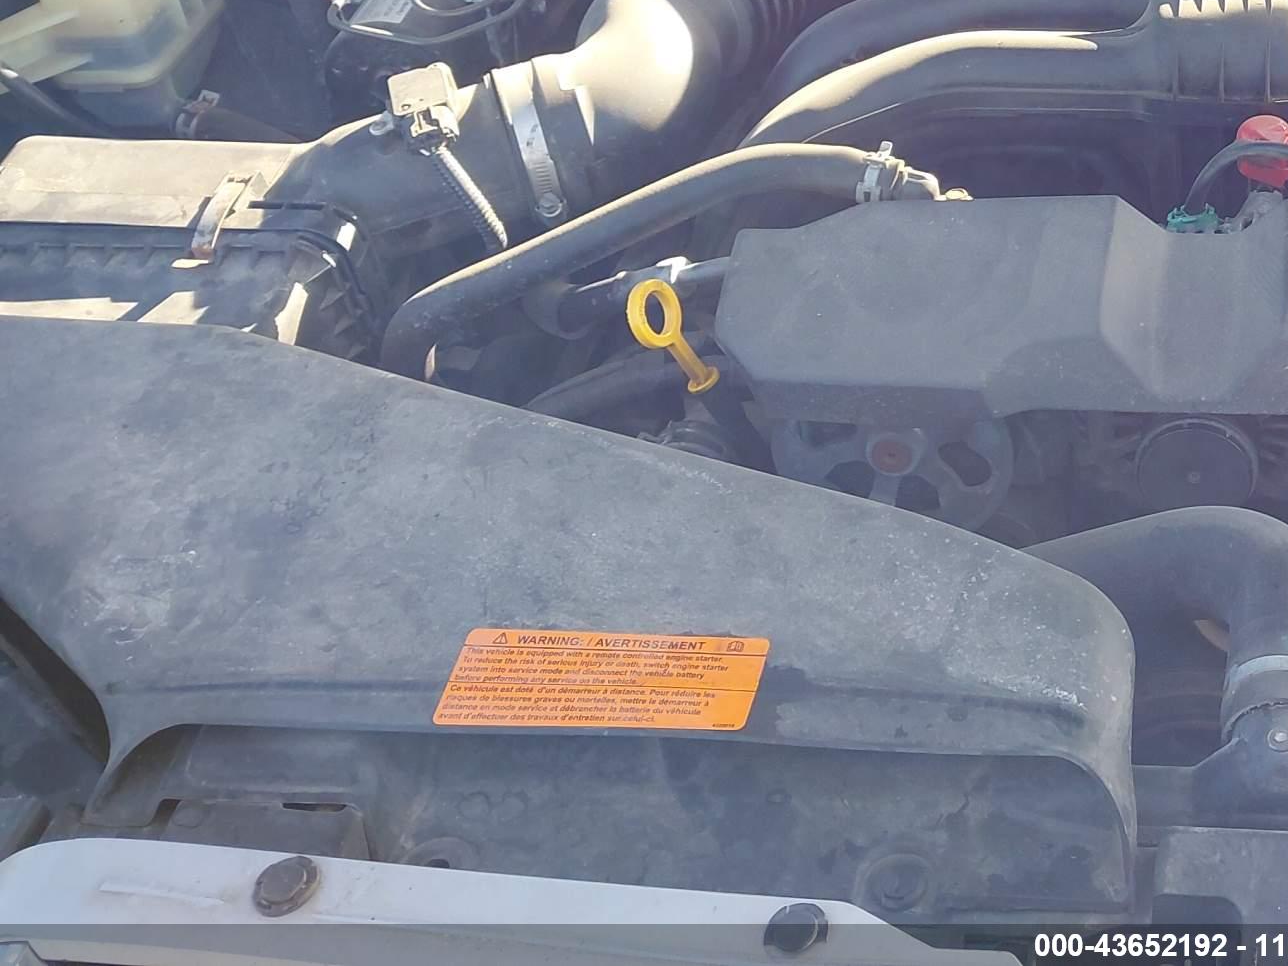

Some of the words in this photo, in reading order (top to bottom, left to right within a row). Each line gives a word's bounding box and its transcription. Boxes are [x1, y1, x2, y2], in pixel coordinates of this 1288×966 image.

[517, 634, 583, 646] WARNING:
[594, 638, 705, 650] AVERTISSEMENT
[526, 649, 563, 658] equipped
[622, 652, 664, 660] controlled
[665, 654, 693, 662] engine
[580, 660, 602, 668] injury
[643, 661, 669, 669] switch
[671, 663, 700, 671] engine
[458, 665, 487, 673] system
[582, 668, 627, 676] disconnect
[676, 671, 704, 679] battery
[483, 674, 528, 683] performing
[530, 676, 545, 684] any
[463, 683, 498, 692] véhicule
[516, 685, 533, 693] doté
[537, 686, 556, 694] d'un
[558, 686, 600, 695] démarreur
[491, 694, 532, 703] blessures
[534, 696, 562, 704] graves
[658, 698, 702, 706] démarreur
[442, 702, 477, 710] distance
[493, 703, 516, 711] mode
[560, 704, 607, 713] débrancher
[618, 705, 650, 713] batterie
[666, 707, 701, 715] véhicule
[464, 712, 509, 721] d'effectuer
[527, 713, 558, 721] travaux
[561, 713, 604, 722] d'entretien
[606, 714, 621, 722] sur
